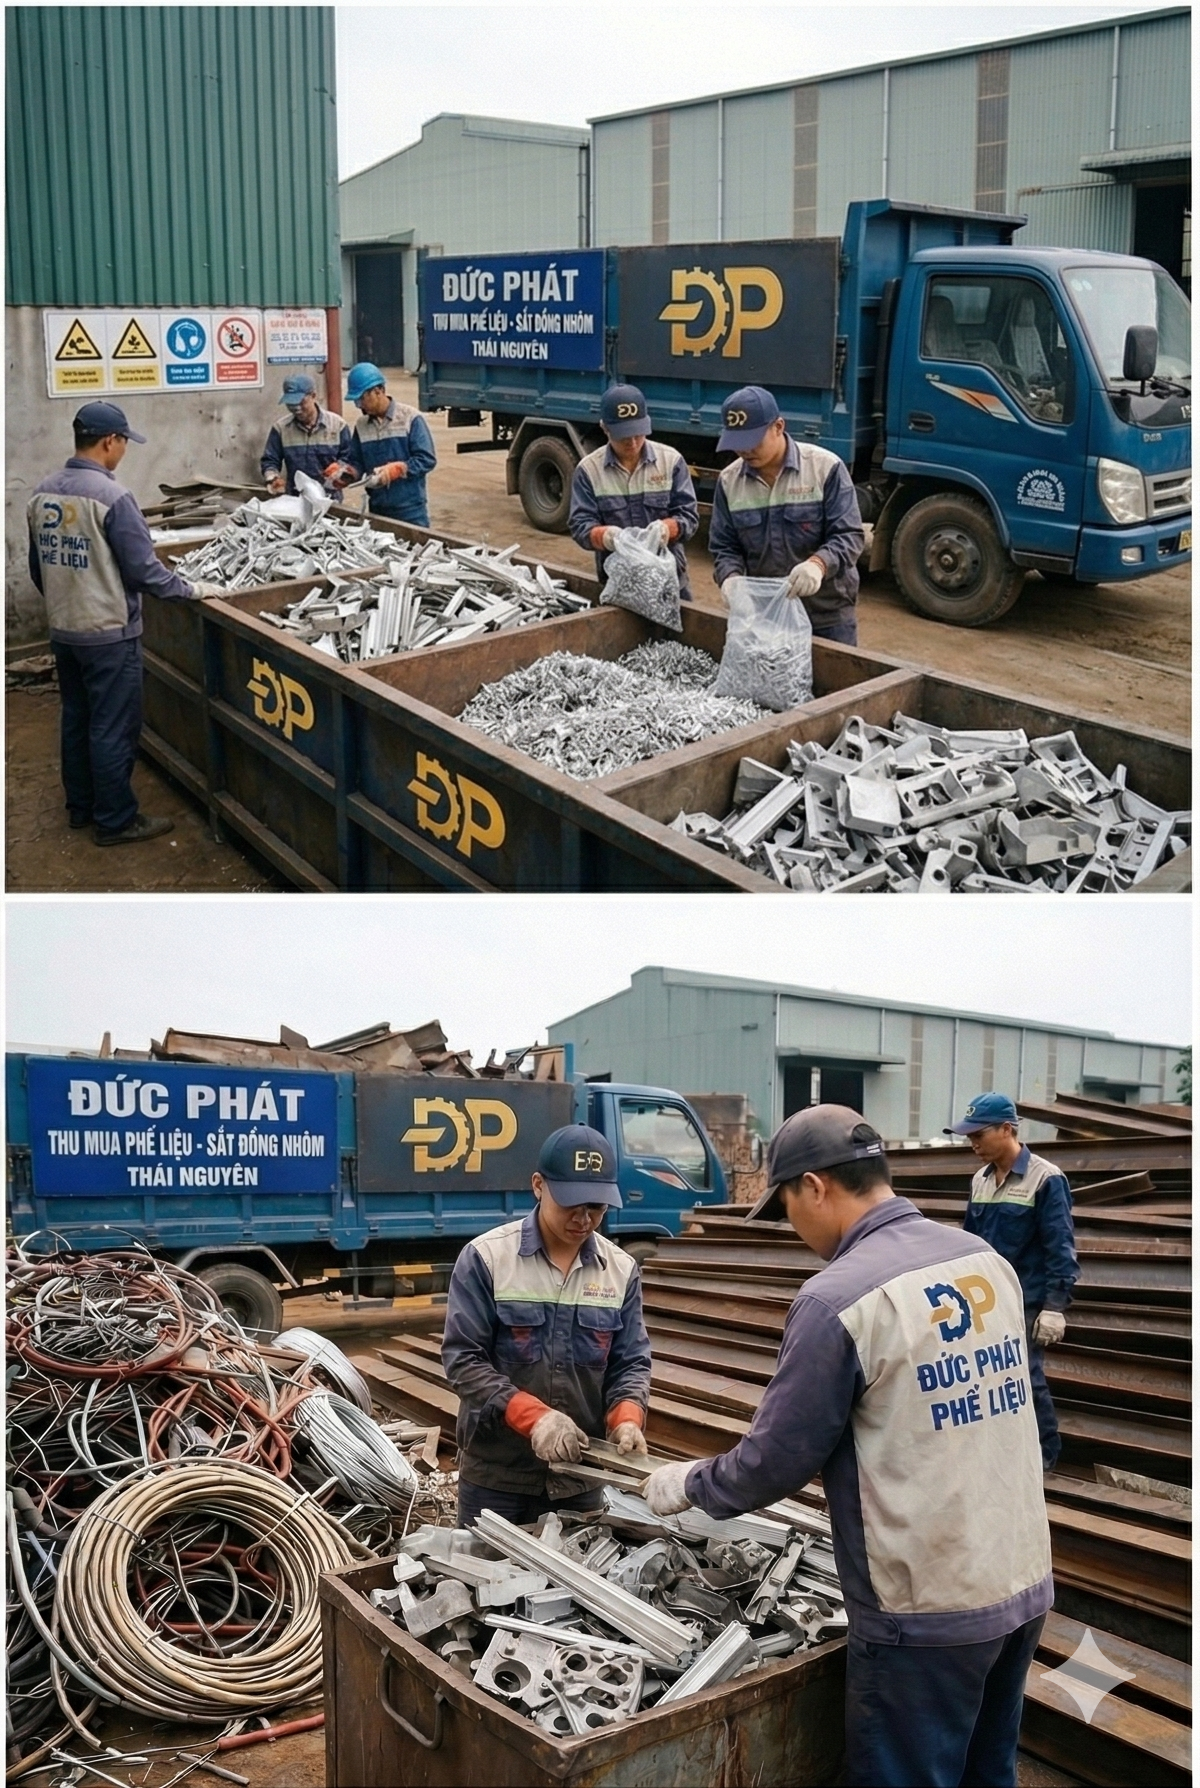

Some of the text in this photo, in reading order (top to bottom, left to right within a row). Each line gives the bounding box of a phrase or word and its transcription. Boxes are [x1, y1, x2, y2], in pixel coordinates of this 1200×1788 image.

[443, 263, 579, 302] ĐỨC PHÁT
[472, 337, 548, 360] THÁI NGUYÊN
[68, 1074, 305, 1122] ĐỨC PHÁT
[48, 1130, 79, 1155] THU
[84, 1130, 121, 1155] MUA
[125, 1124, 157, 1156] PHẾ
[160, 1127, 193, 1161] LIỆU
[207, 1124, 235, 1156] SẮT
[282, 1130, 325, 1157] NHÔM
[127, 1162, 258, 1187] THÁI NGUYÊN
[916, 1335, 1023, 1392] ĐỨC PHÁT
[988, 1376, 1027, 1417] LIỆU
